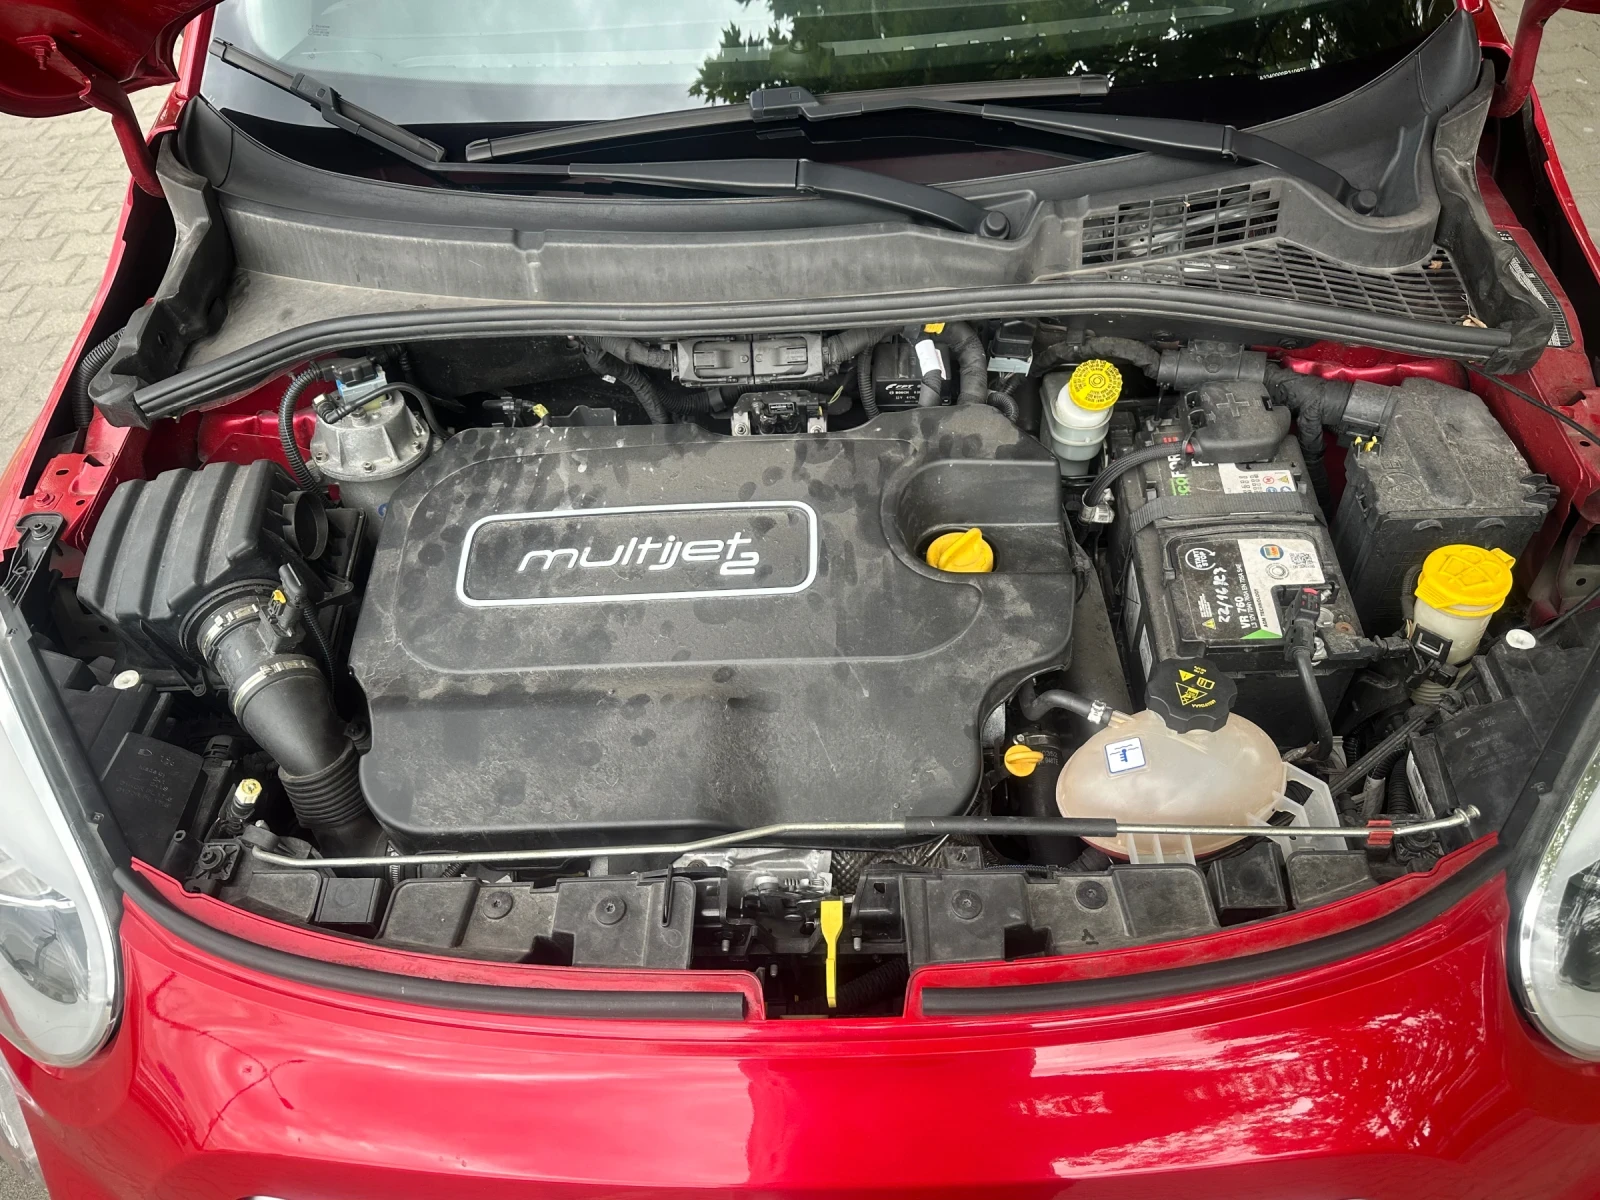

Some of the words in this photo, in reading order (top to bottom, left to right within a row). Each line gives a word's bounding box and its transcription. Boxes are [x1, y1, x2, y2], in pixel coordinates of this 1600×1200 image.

[517, 532, 752, 572] multijet
[1193, 550, 1202, 568] START
[1200, 551, 1209, 567] STOP
[1234, 596, 1247, 613] 760
[1240, 616, 1251, 629] VR
